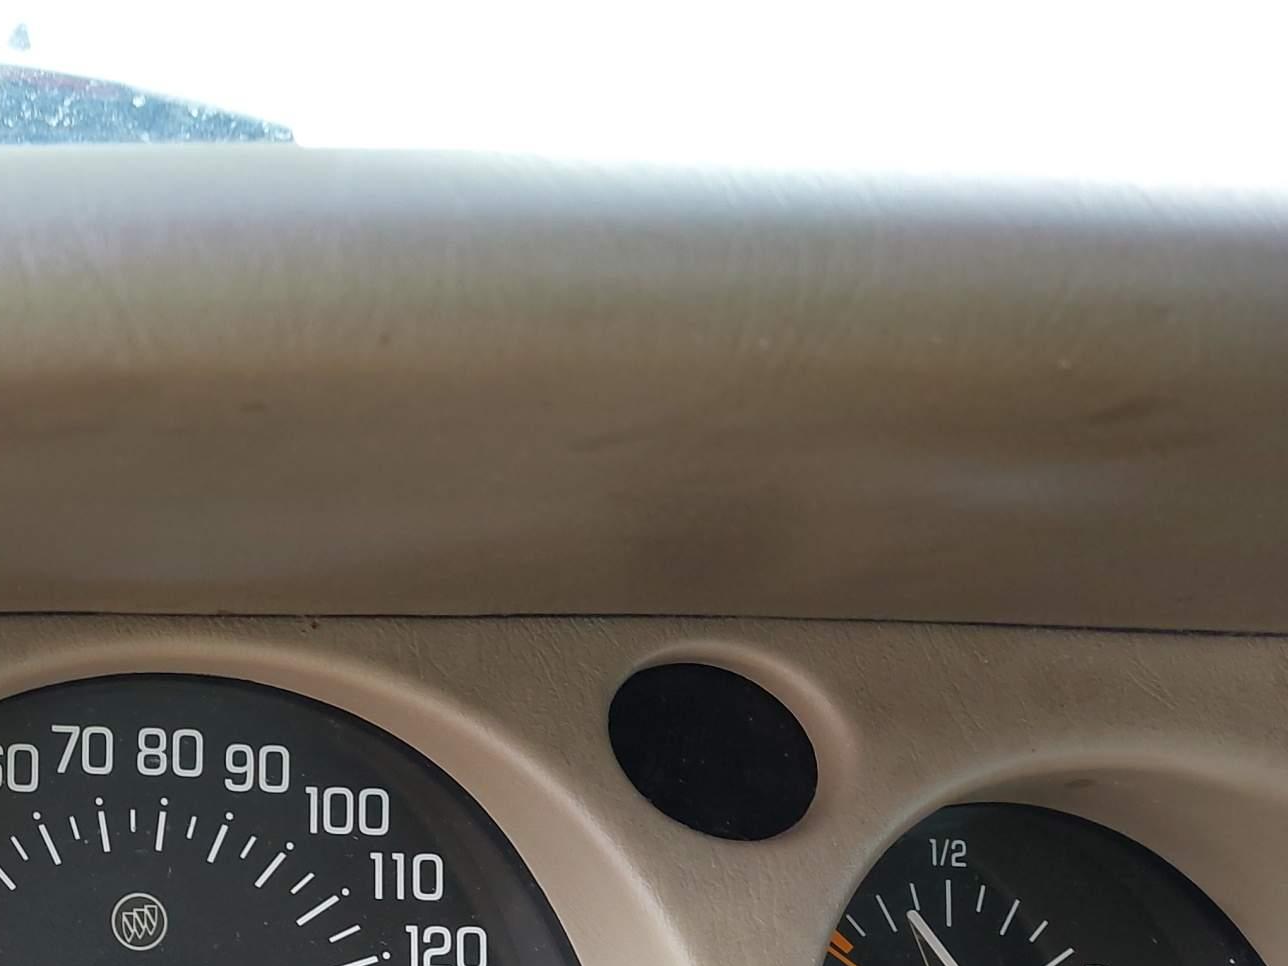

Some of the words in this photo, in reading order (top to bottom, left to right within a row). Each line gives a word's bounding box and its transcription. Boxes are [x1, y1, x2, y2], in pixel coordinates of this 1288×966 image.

[51, 724, 114, 775] 70
[136, 727, 204, 777] 80
[224, 743, 290, 793] 90
[305, 786, 390, 836] 100
[370, 852, 444, 901] 110
[929, 838, 967, 868] 1/2
